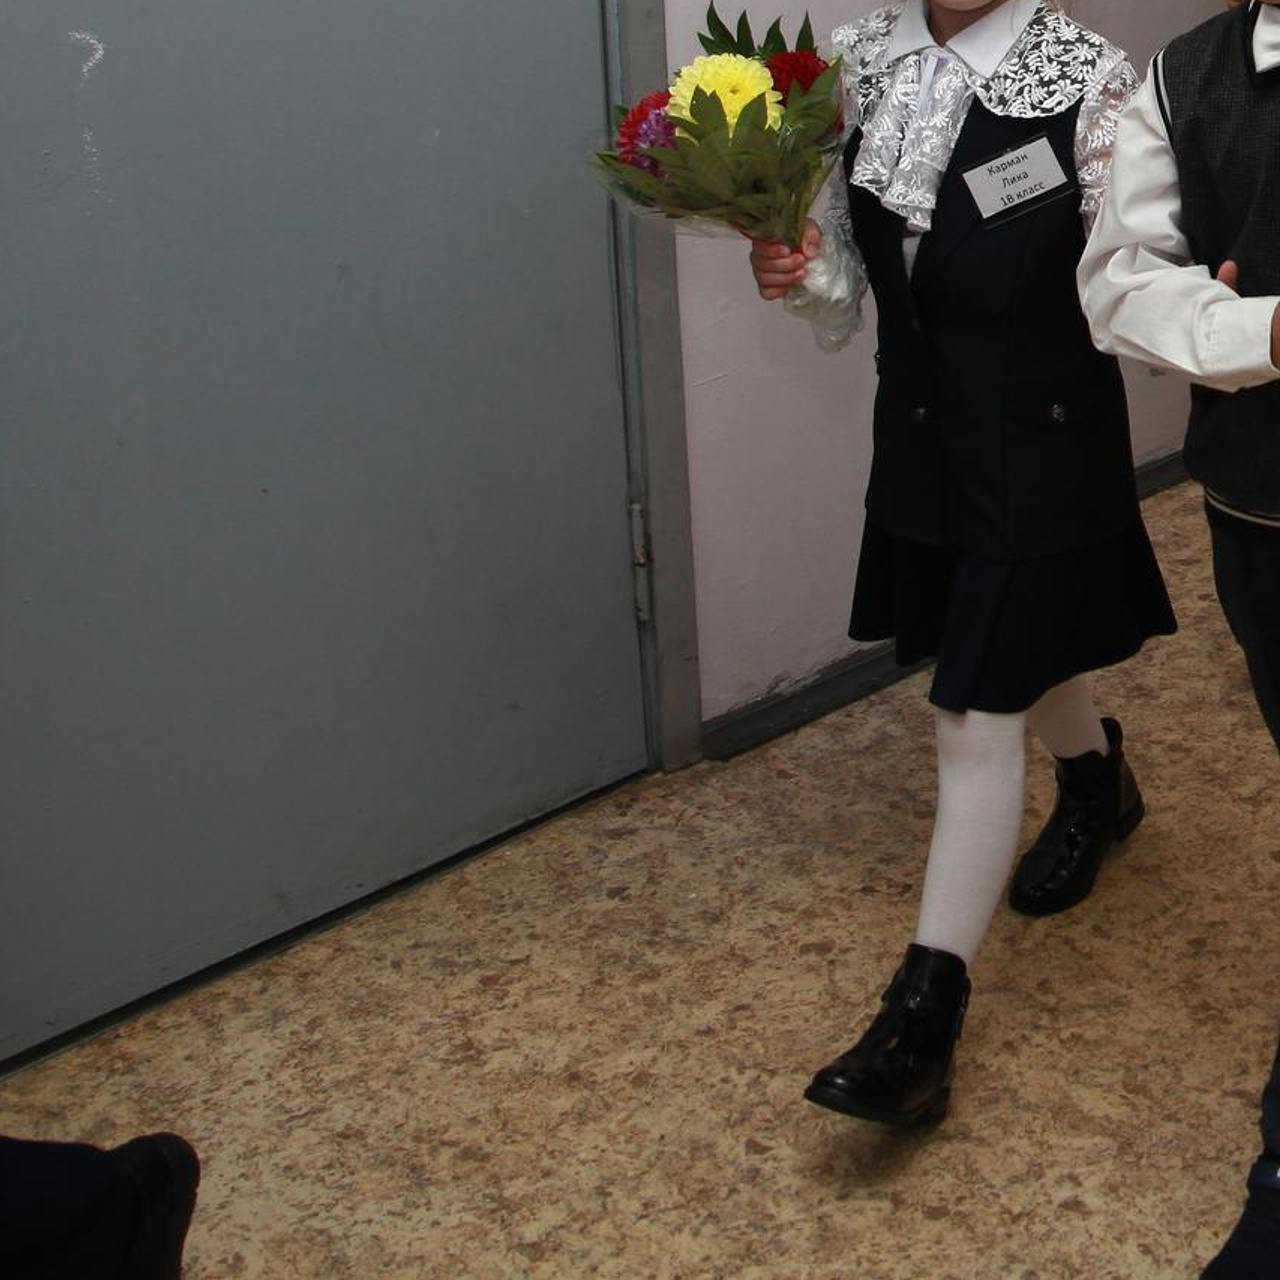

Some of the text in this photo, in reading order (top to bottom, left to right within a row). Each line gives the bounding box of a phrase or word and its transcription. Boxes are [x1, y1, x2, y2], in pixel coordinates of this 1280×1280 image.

[987, 153, 1029, 176] Карман
[1001, 171, 1030, 189] Лика
[1016, 182, 1046, 200] класс
